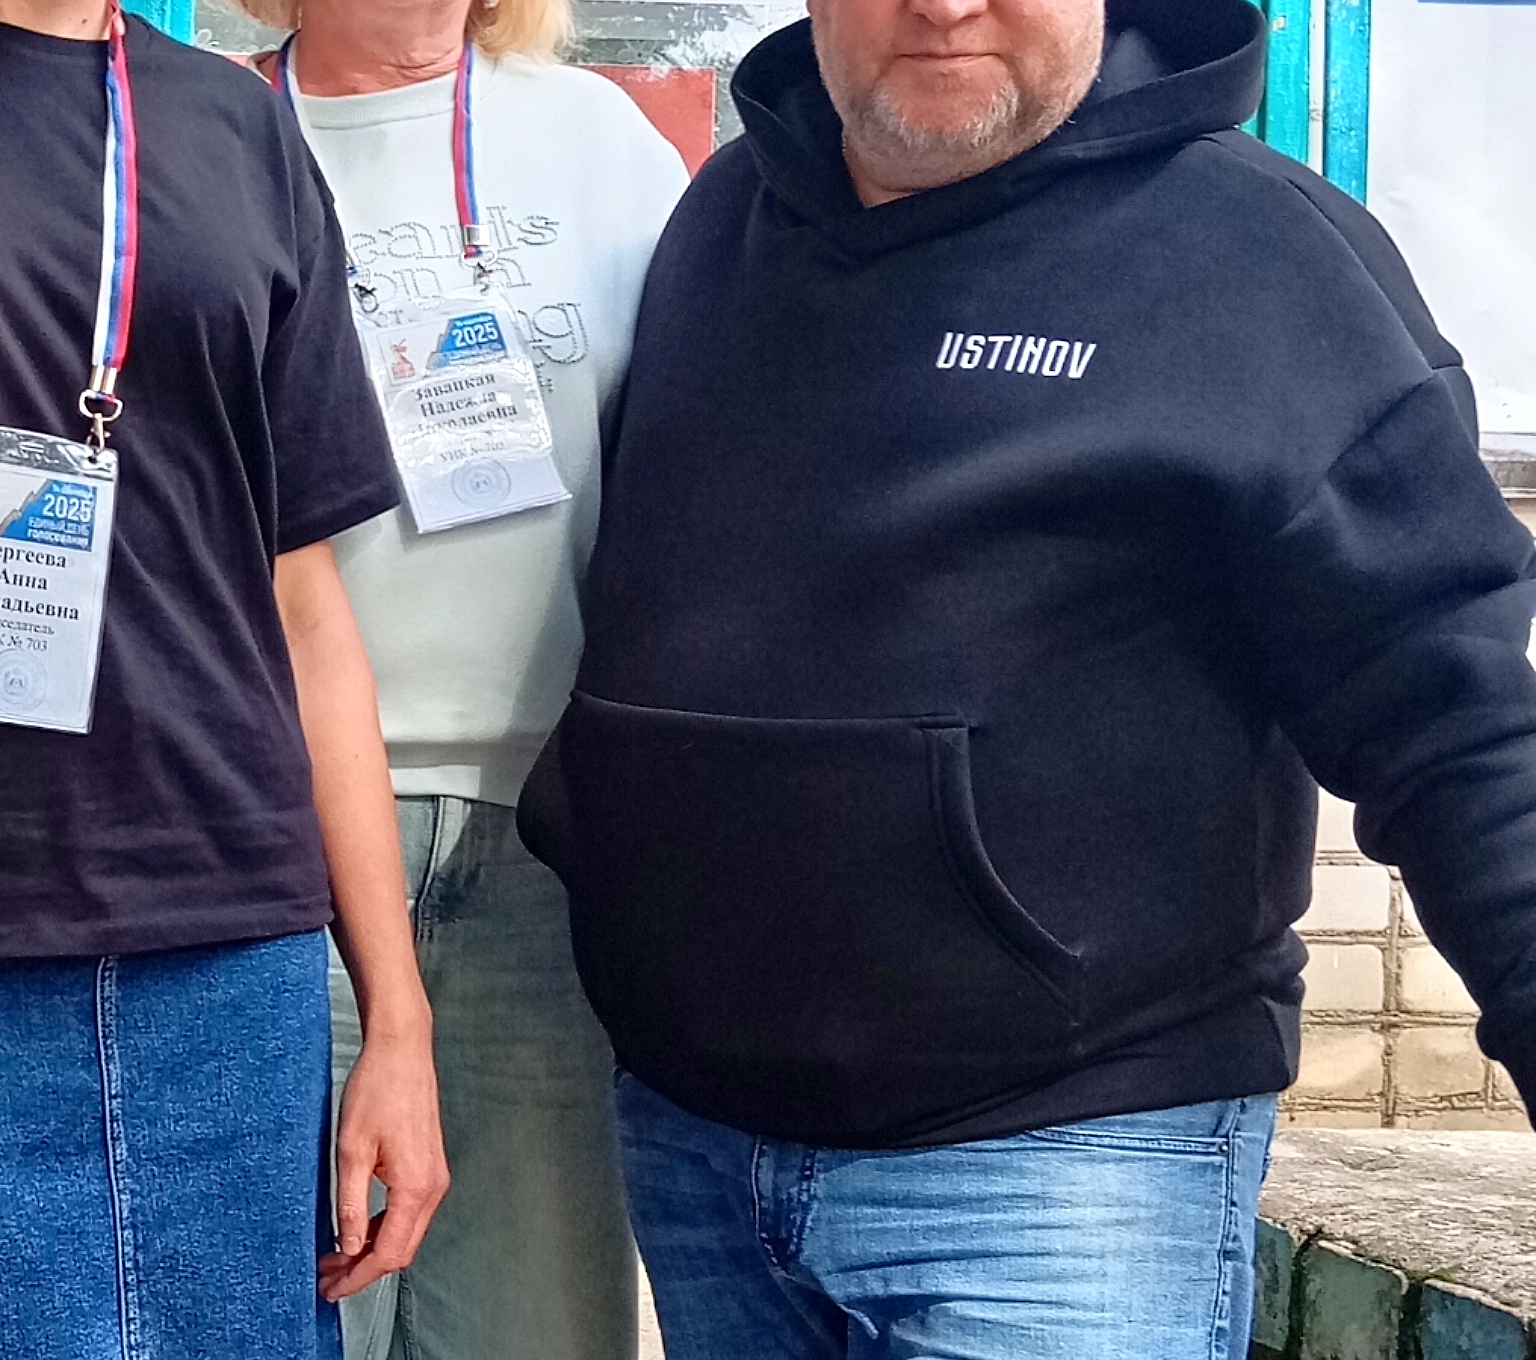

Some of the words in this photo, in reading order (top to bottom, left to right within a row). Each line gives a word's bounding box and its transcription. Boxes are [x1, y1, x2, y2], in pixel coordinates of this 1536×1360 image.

[451, 321, 499, 347] 2025
[936, 331, 1098, 379] USTINOV
[42, 493, 92, 522] 2025
[26, 637, 48, 652] 703
